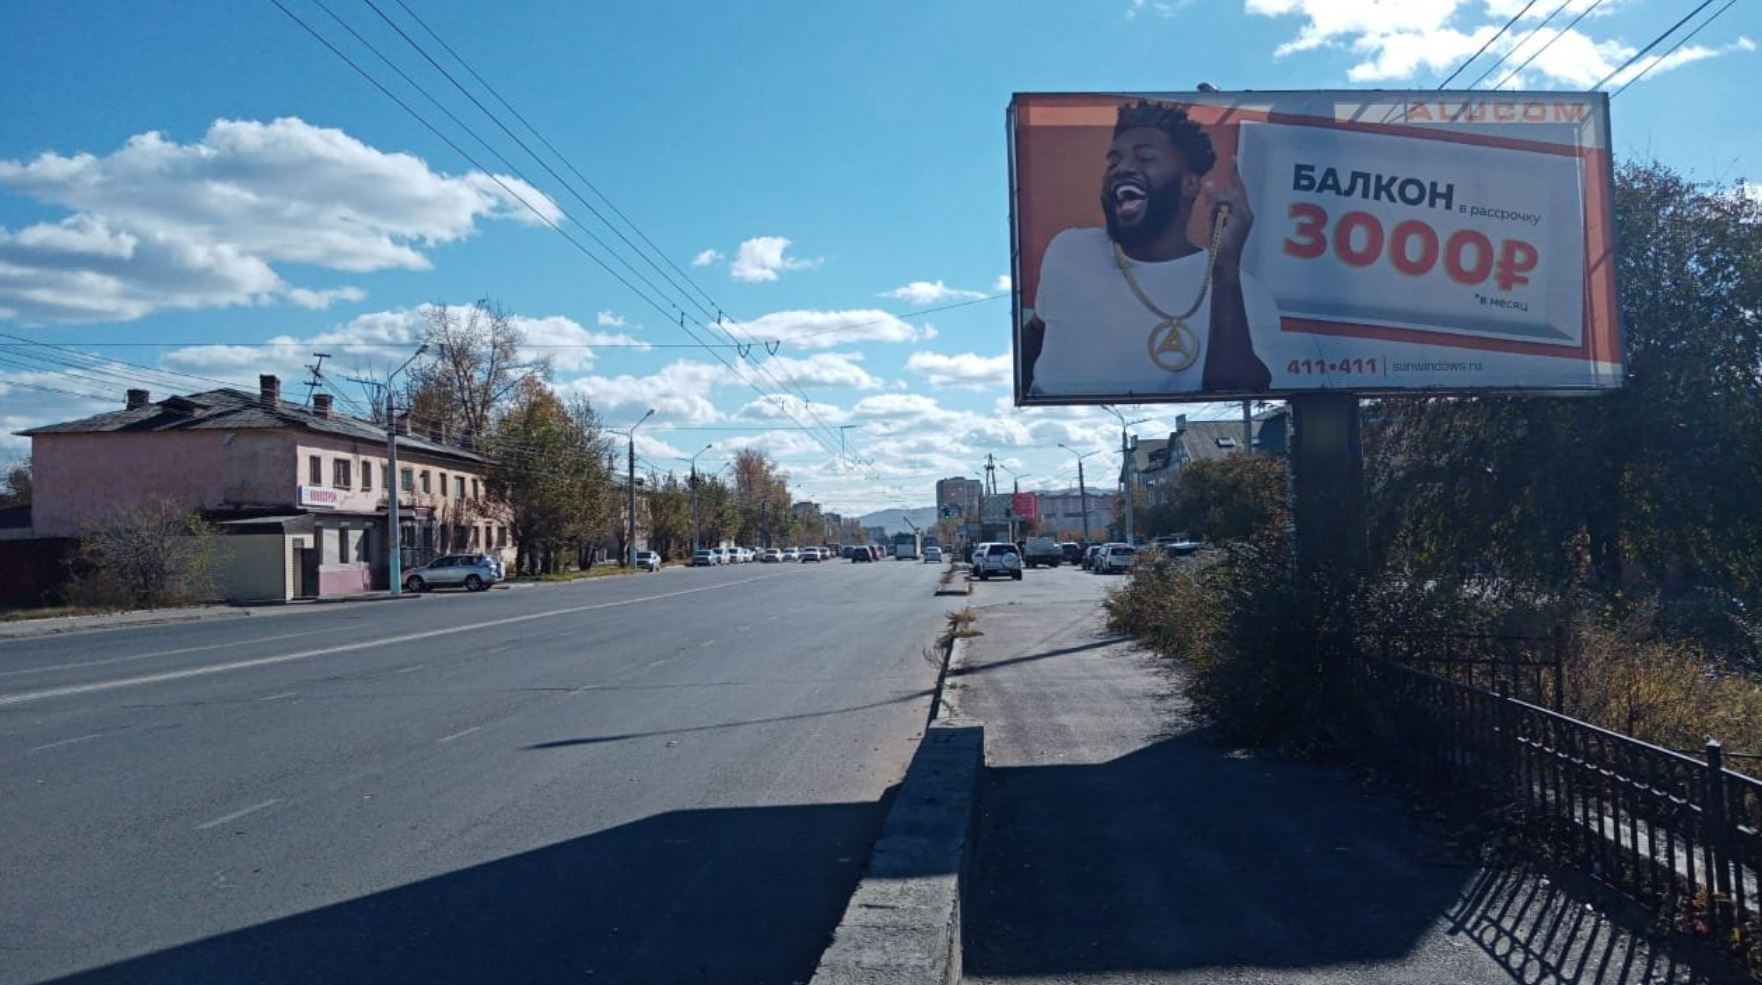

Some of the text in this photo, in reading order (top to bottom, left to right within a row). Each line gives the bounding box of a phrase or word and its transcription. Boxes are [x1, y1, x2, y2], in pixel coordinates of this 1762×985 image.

[1408, 101, 1586, 121] ALUCOM
[1293, 163, 1455, 210] БАЛКОН
[1471, 205, 1541, 226] рассрочку
[1284, 202, 1539, 291] 3000₽
[1391, 360, 1484, 373] sunwindows.ru
